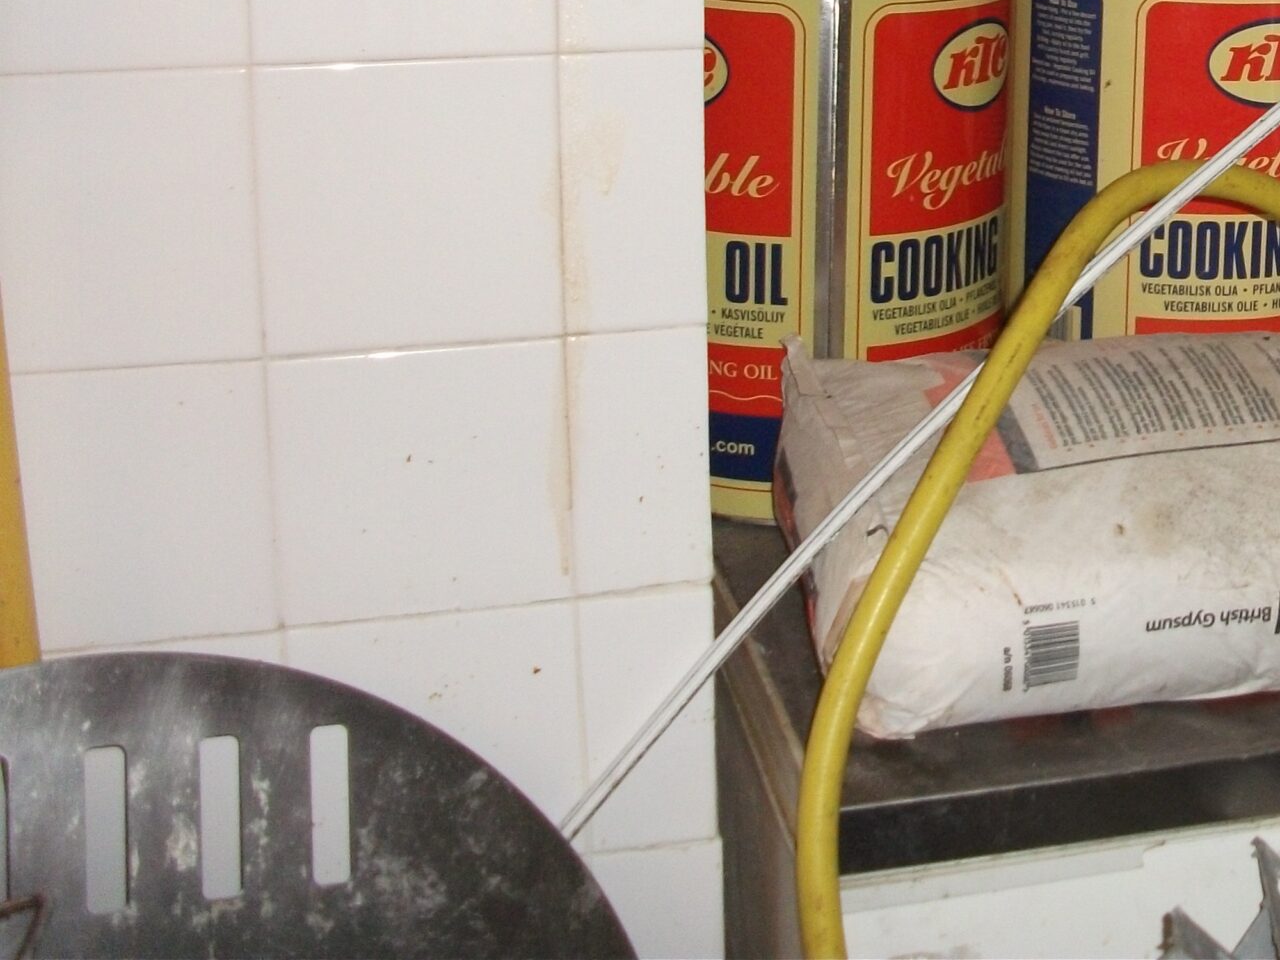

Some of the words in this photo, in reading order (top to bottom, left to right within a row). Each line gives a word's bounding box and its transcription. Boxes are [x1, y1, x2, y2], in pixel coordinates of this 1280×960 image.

[870, 214, 999, 305] COOKING
[725, 240, 788, 306] OIL
[1141, 282, 1212, 297] VEGETABILISK
[1214, 284, 1238, 297] OLJA
[873, 302, 937, 321] VEGETABILISK
[1163, 300, 1234, 313] VEGETABILISK
[1237, 300, 1258, 312] OLIE
[895, 314, 953, 336] VEGETABILISK
[744, 363, 778, 380] OIL
[1145, 606, 1215, 632] Gypsum
[1220, 606, 1273, 626] British
